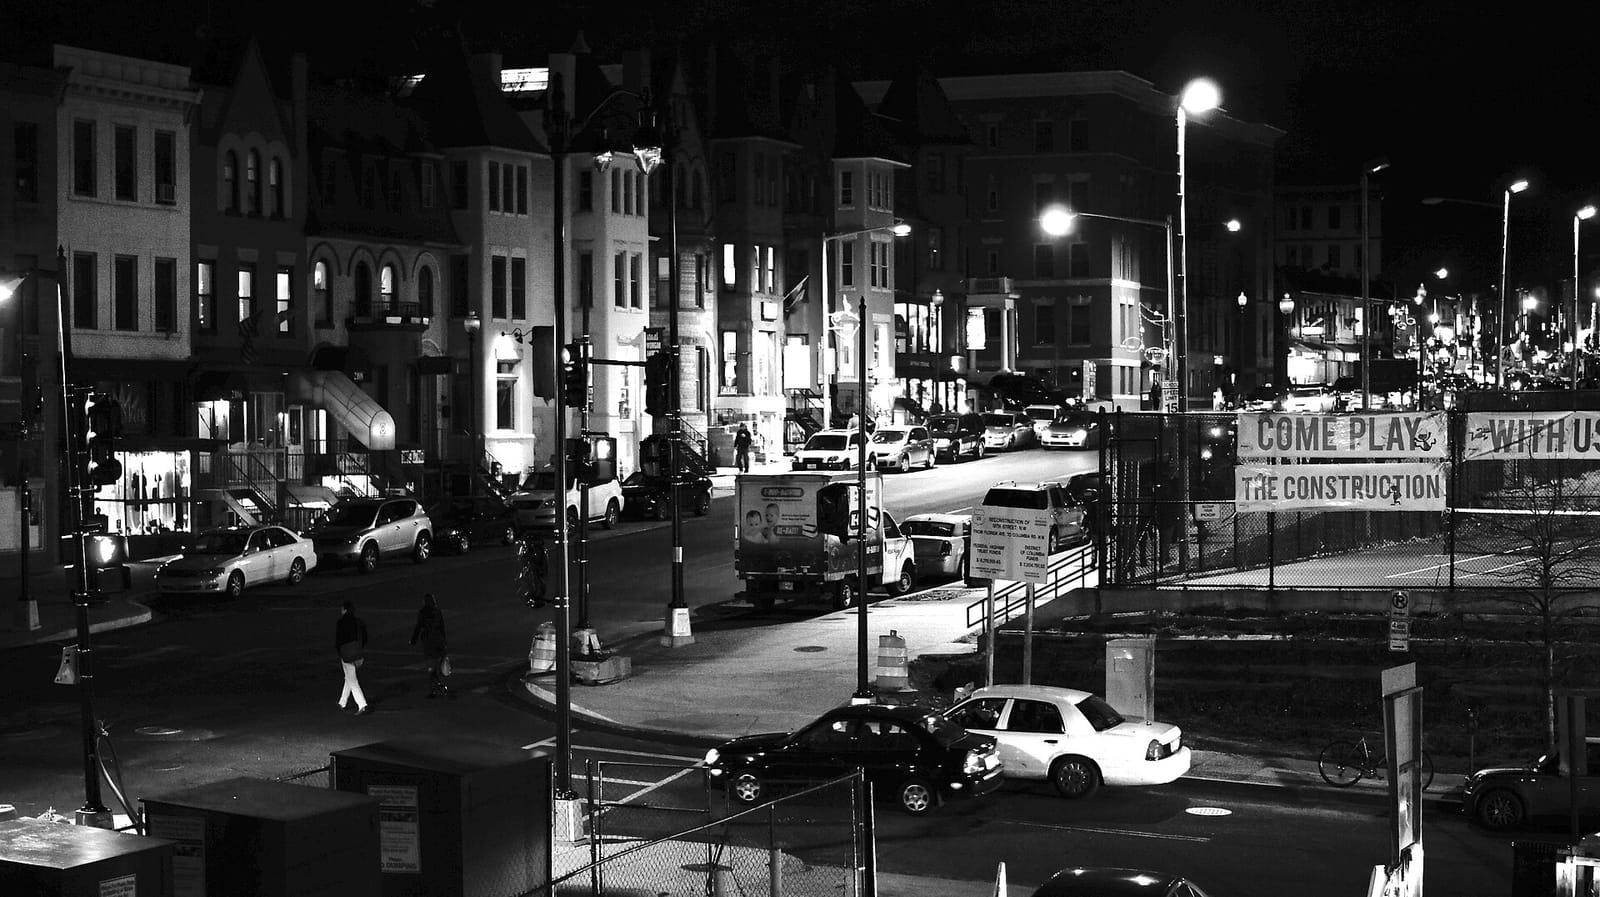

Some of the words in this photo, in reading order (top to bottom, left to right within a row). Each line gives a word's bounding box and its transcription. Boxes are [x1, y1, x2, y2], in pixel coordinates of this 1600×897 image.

[1165, 402, 1178, 413] 15
[1257, 415, 1337, 450] COME
[1350, 416, 1423, 450] PLAY
[1488, 419, 1565, 453] WITH
[1242, 476, 1278, 500] THE
[1284, 474, 1440, 500] CONSTRUCTION
